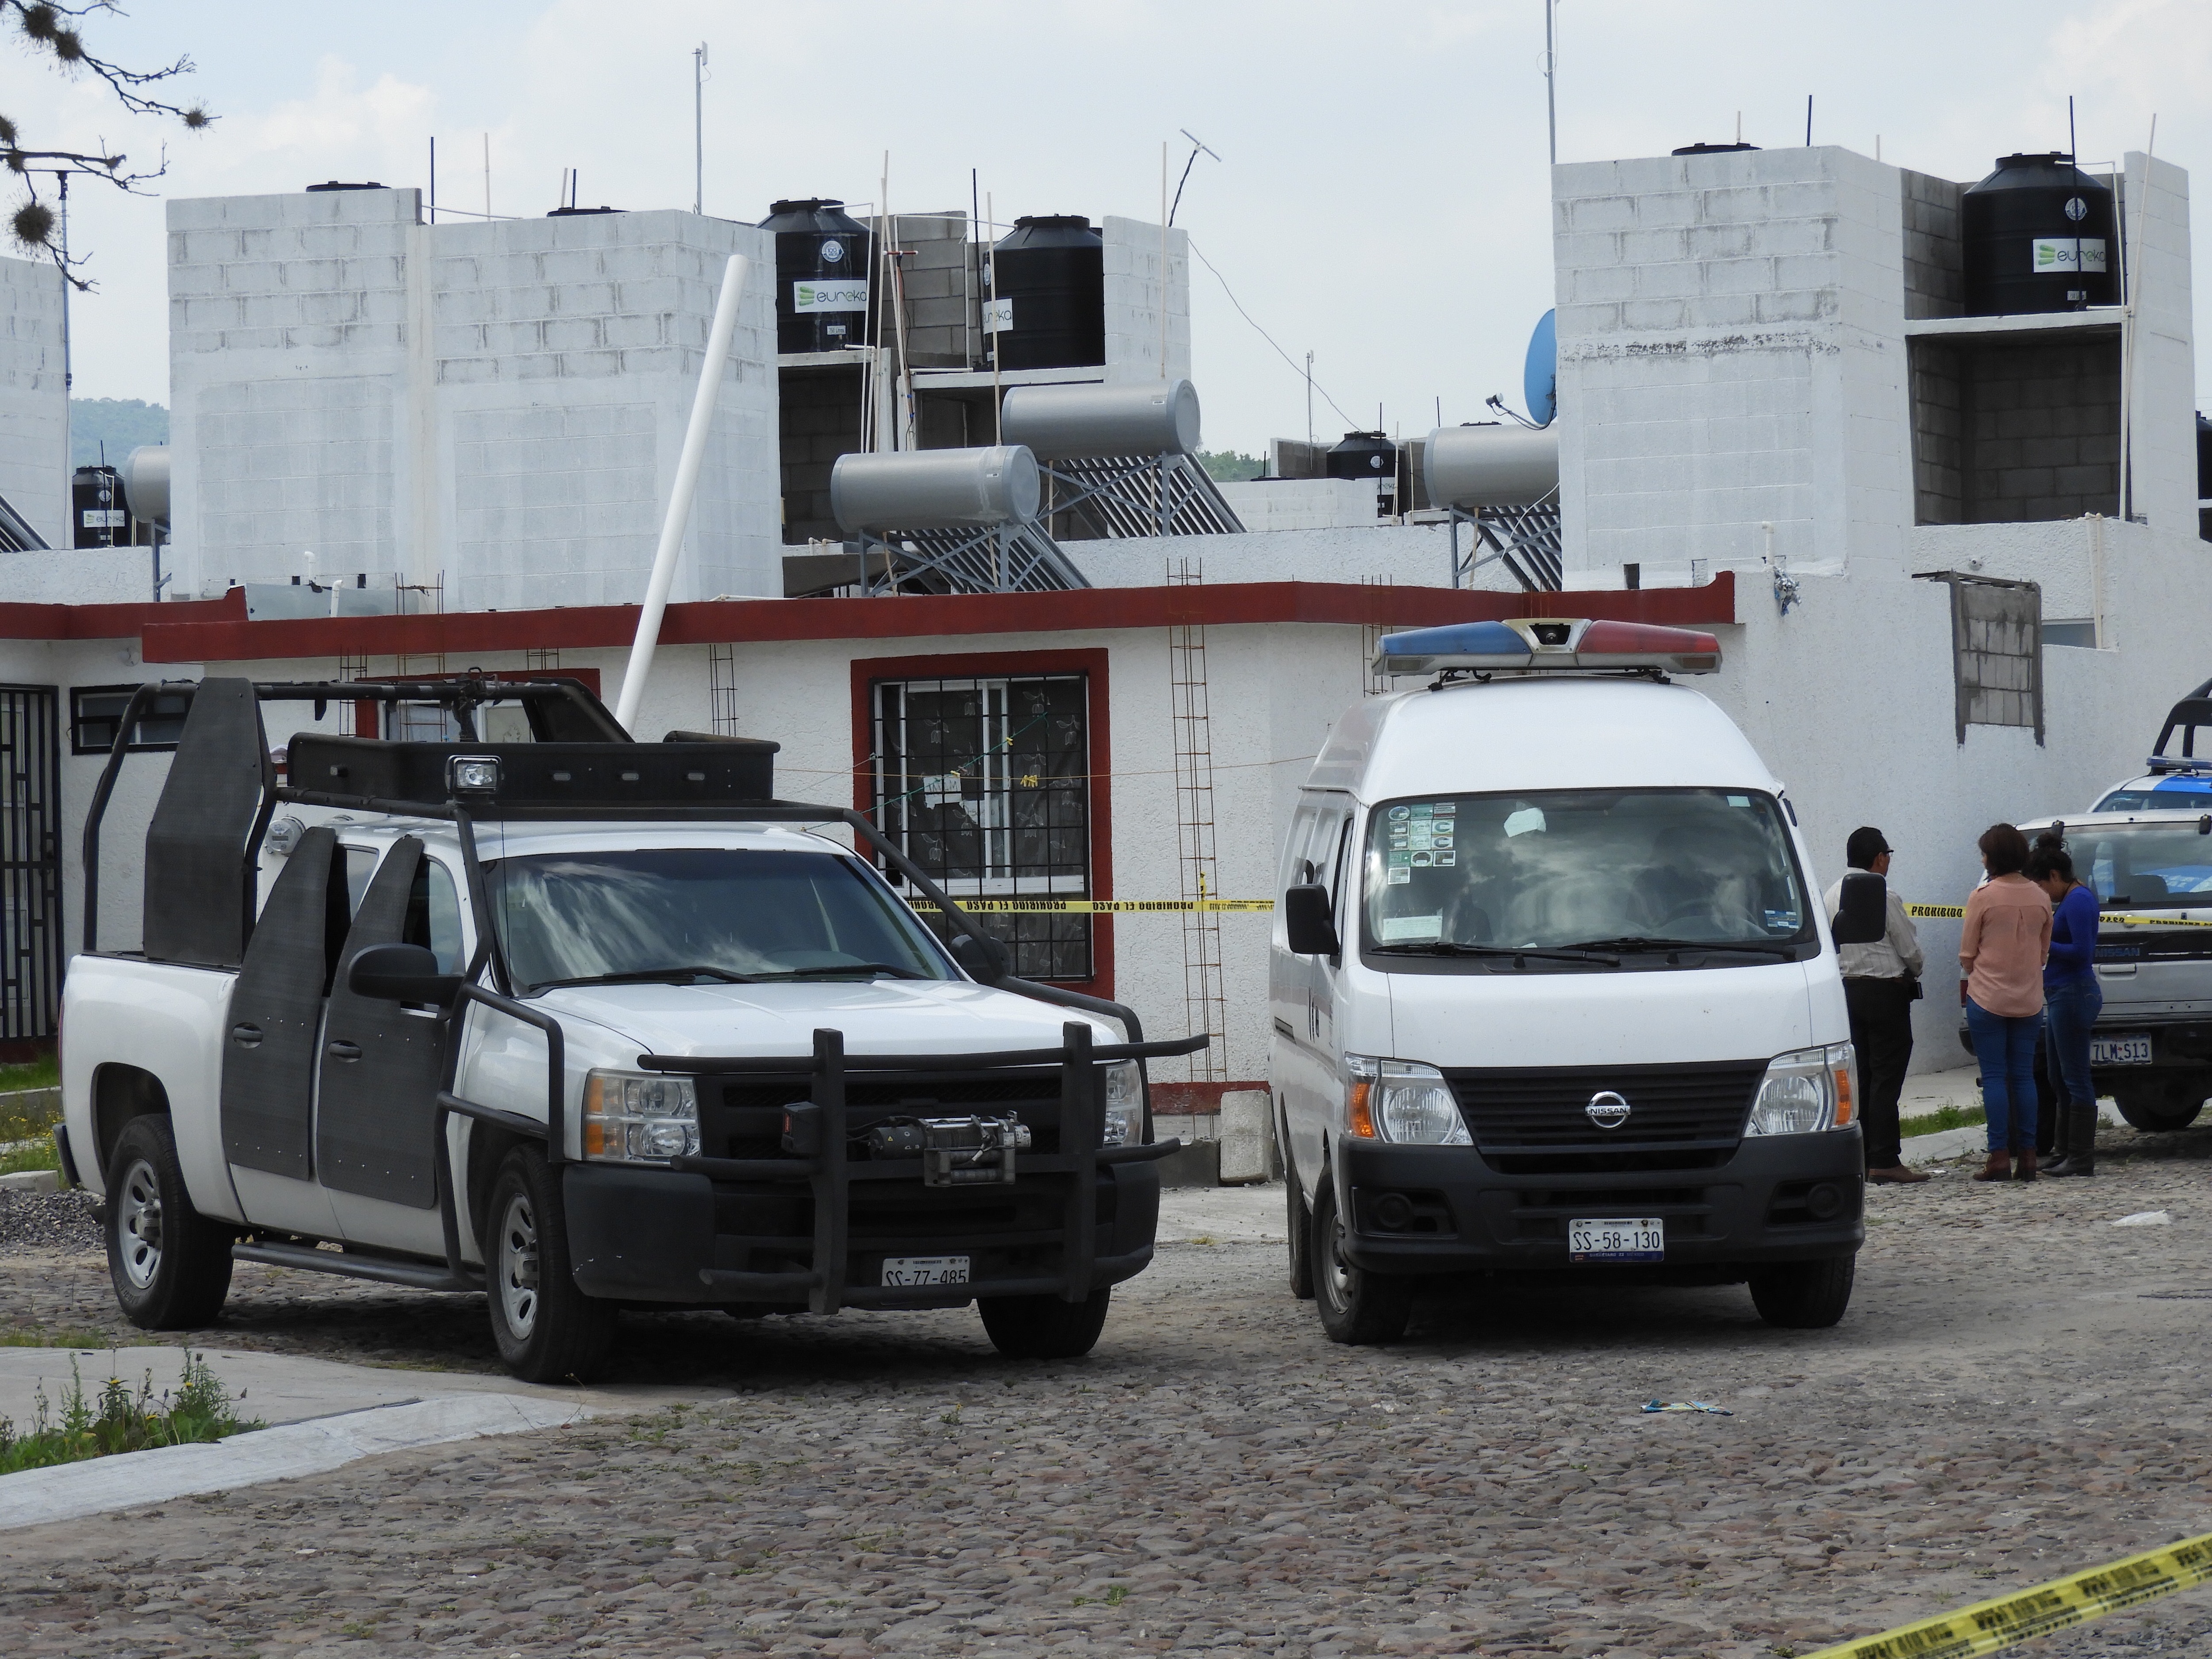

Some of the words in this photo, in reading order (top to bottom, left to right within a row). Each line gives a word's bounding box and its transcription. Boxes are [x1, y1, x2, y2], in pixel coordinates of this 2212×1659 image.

[817, 290, 867, 302] eureka
[1139, 902, 1194, 910] PROHIBIDO
[1911, 906, 1963, 918] PROHIBIDO
[1573, 1231, 1660, 1250] SS-58-130
